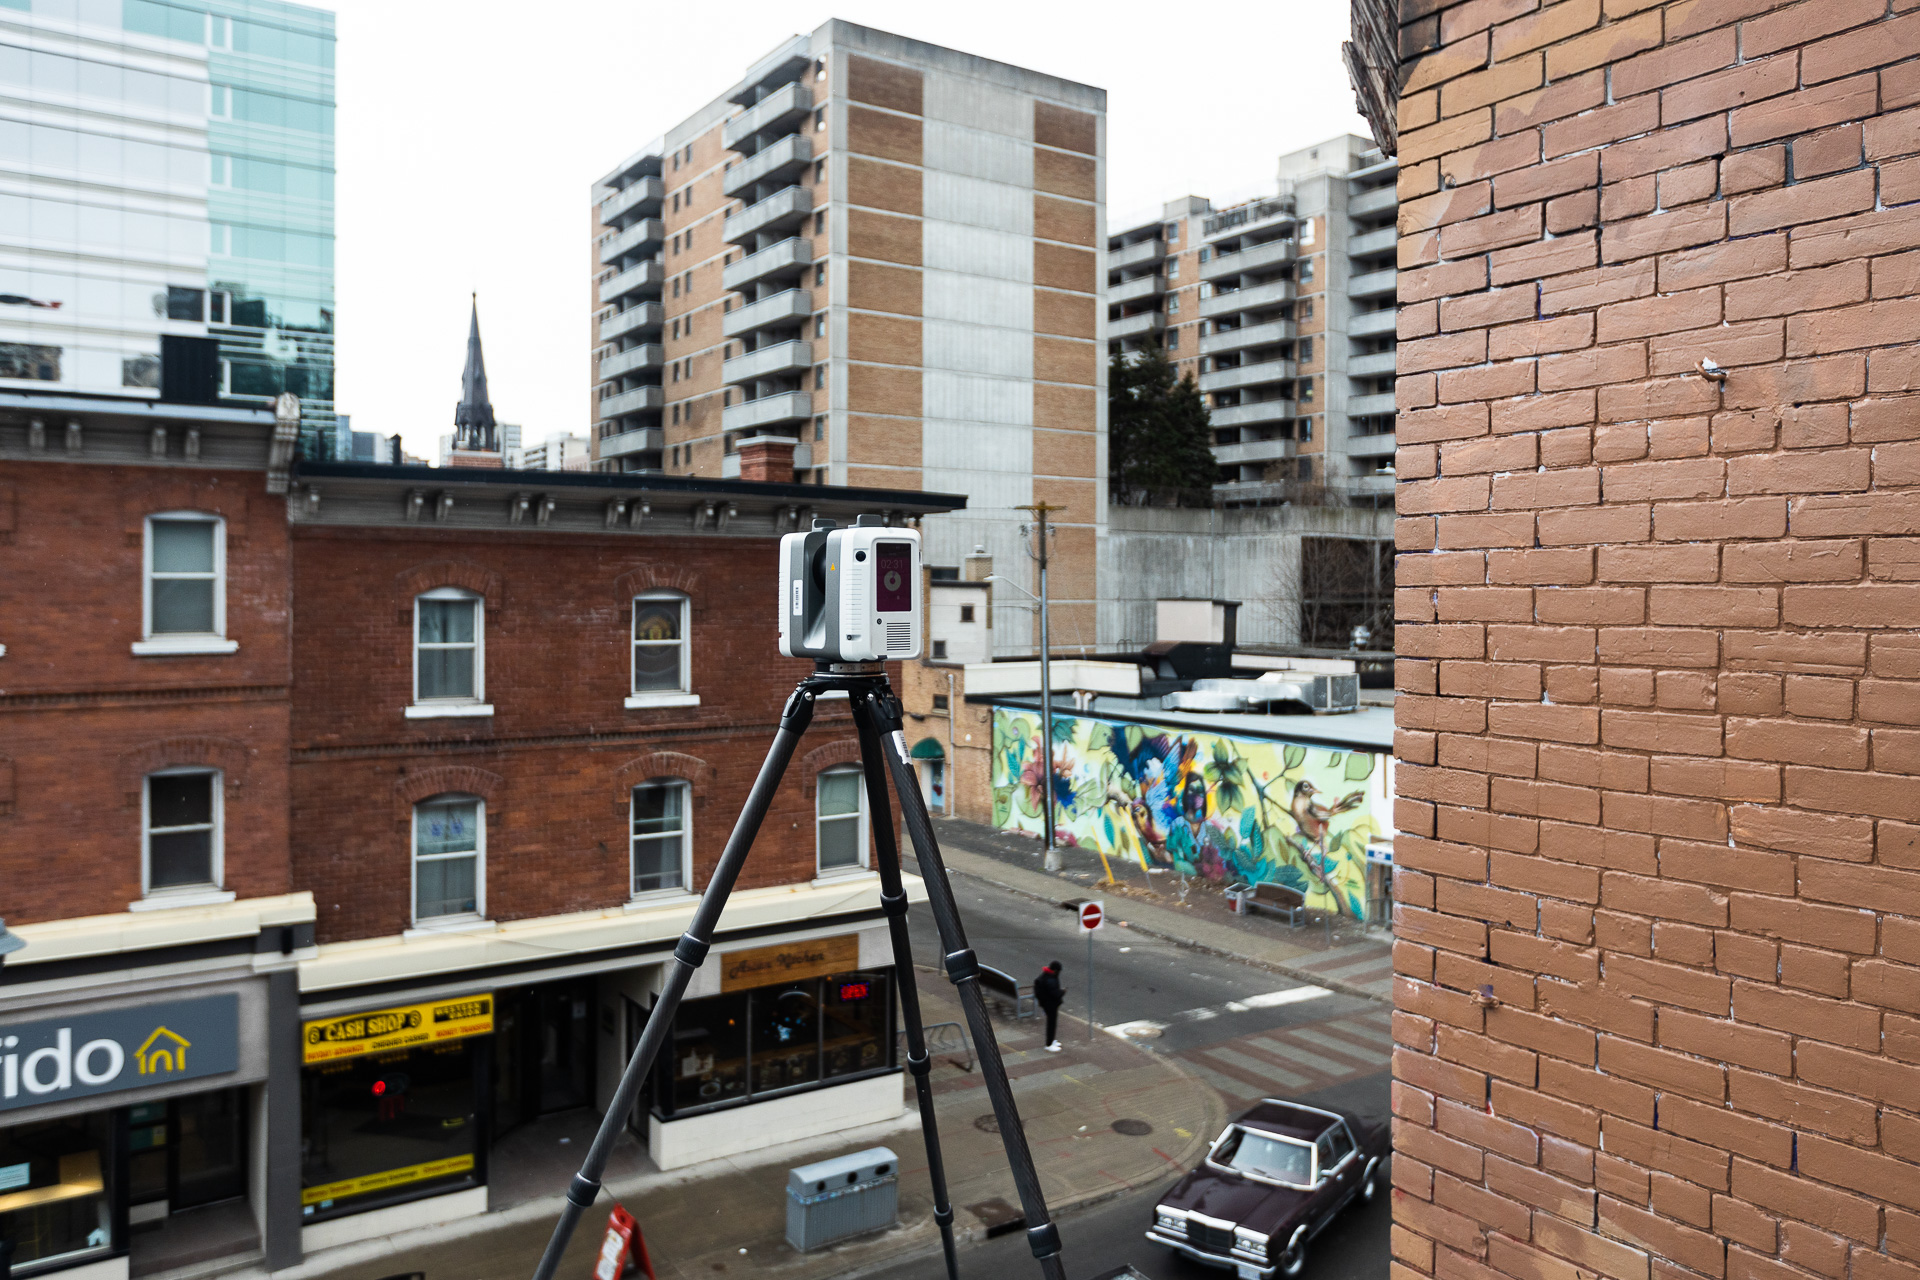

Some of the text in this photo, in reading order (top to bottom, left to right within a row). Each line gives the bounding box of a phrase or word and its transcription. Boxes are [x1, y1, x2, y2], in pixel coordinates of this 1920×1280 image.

[880, 559, 903, 569] 02:31
[324, 1012, 407, 1041] CASH SHOP
[0, 1027, 125, 1099] ido
